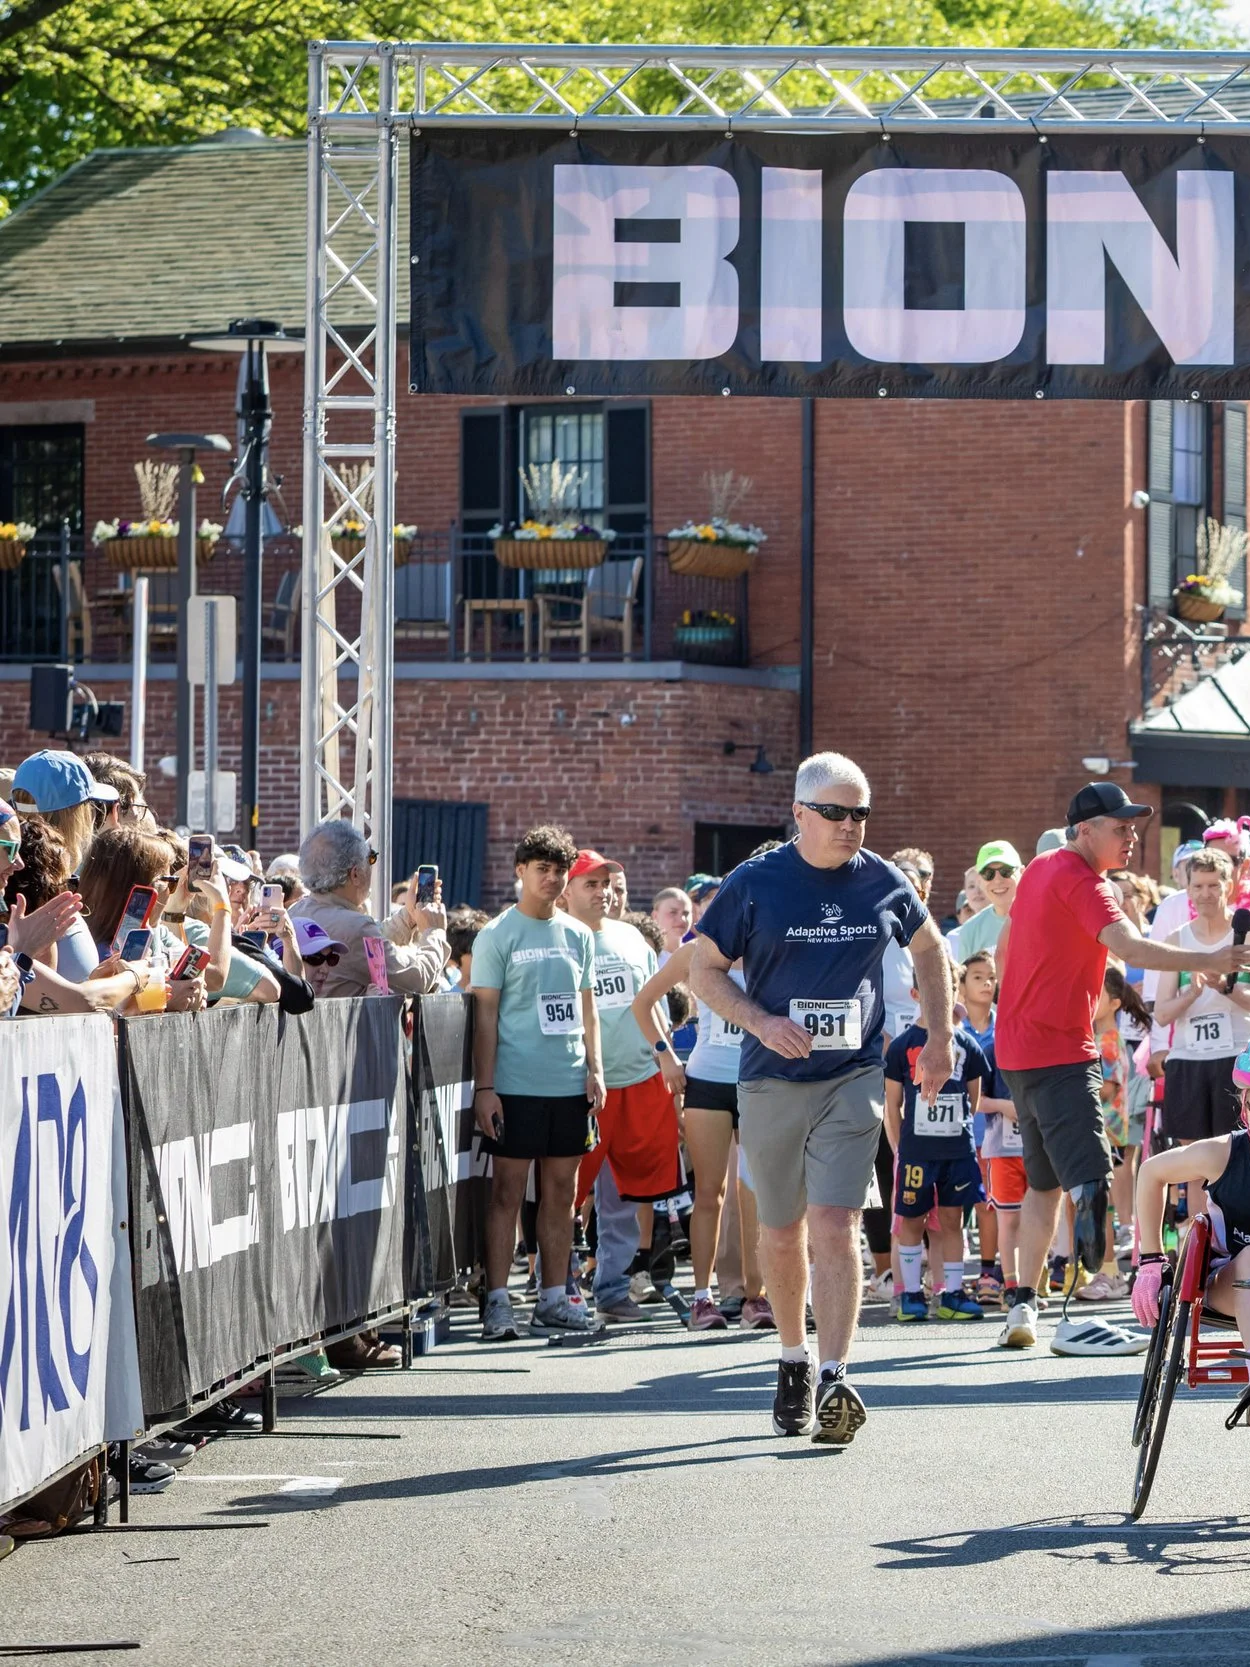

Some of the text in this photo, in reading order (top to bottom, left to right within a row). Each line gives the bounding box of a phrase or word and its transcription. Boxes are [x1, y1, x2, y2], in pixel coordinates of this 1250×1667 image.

[786, 924, 877, 939] Adaptive Sports
[824, 935, 854, 943] ENGLAND
[594, 976, 626, 997] 950
[541, 993, 573, 1001] BIONIC
[797, 1001, 844, 1009] BIONIC
[546, 1003, 575, 1022] 954
[804, 1013, 846, 1037] 931
[1194, 1022, 1220, 1042] 713
[927, 1104, 955, 1123] 871
[904, 1164, 924, 1189] 19
